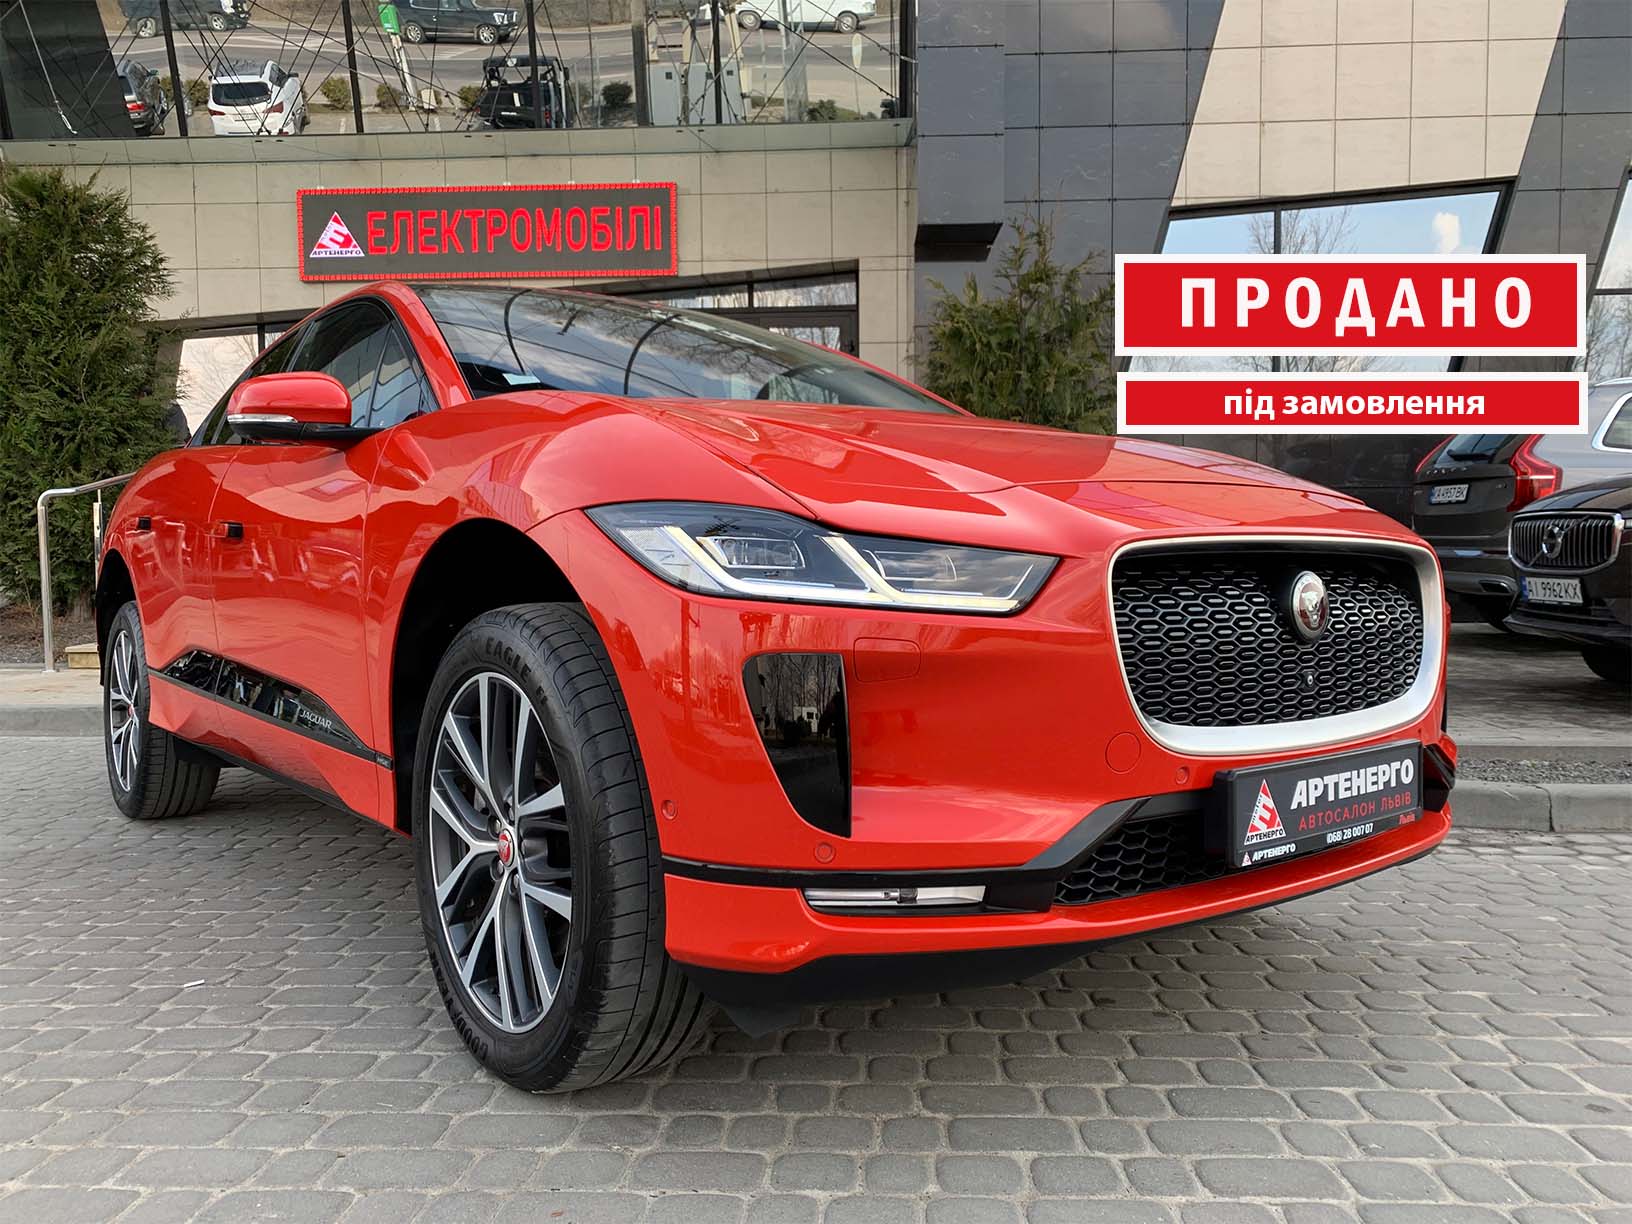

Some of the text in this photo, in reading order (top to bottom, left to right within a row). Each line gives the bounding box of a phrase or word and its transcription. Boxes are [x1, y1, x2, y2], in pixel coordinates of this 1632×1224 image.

[366, 205, 662, 255] ЕЛЕКТРОМОБІЛІ
[485, 636, 531, 684] EAGLE
[300, 710, 332, 729] JAGUAR
[1290, 758, 1414, 810] АРТЕНЕРГО
[1298, 791, 1412, 831] АВТОСАЛОН ЛЬВІВ
[1246, 828, 1284, 843] АРТЕНЕРГО
[1343, 828, 1351, 840] 28
[1352, 825, 1364, 837] 007
[1365, 823, 1374, 834] 07
[1252, 843, 1296, 861] АРТЕНЕРГО
